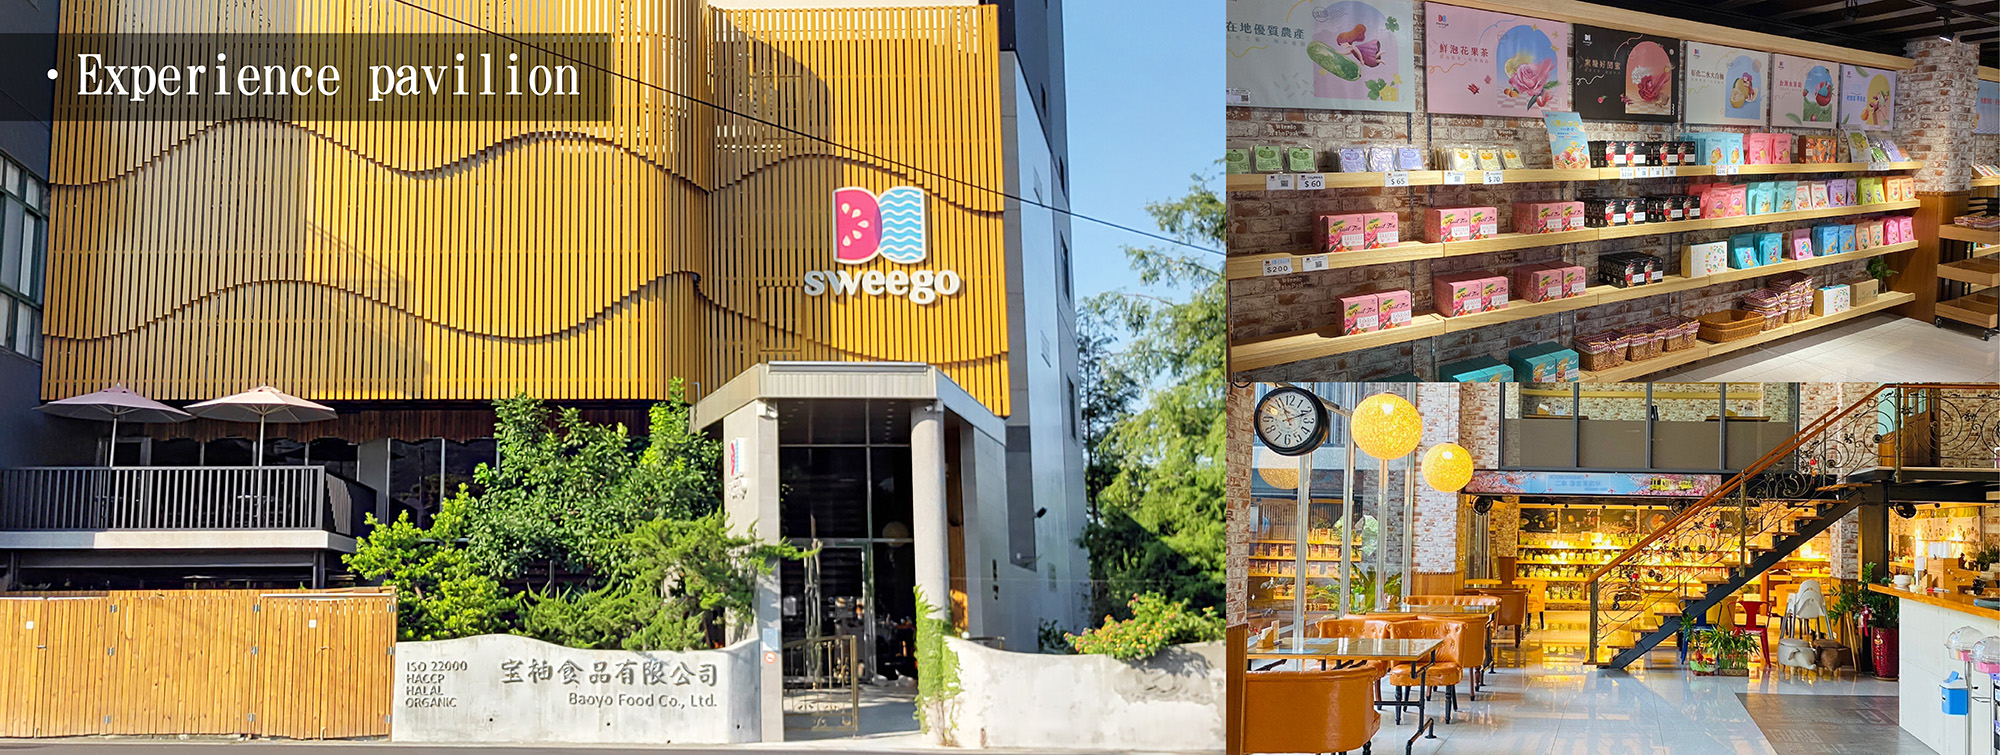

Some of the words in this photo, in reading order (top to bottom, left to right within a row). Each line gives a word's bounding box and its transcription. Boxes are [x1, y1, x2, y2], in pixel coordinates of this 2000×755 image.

[1226, 20, 1304, 40] 在地優質農產
[1440, 43, 1488, 58] 鮮泡花果茶
[804, 270, 961, 305] sweego
[1286, 395, 1295, 406] 12
[1297, 400, 1304, 408] 1
[1265, 425, 1276, 434] 8
[1301, 426, 1311, 434] 4
[1274, 431, 1282, 441] 7
[1284, 434, 1291, 445] 6
[1293, 431, 1302, 442] 5
[406, 662, 427, 672] ISO
[431, 660, 468, 672] 22000
[501, 658, 718, 687] 宝柚食品有限公司
[406, 673, 445, 684] HACCP
[406, 686, 444, 696] HALAL
[406, 697, 457, 708] ORGANIC
[569, 692, 613, 708] Baoyo
[618, 693, 654, 707] Food
[658, 694, 686, 708] Co.,
[690, 694, 717, 707] Ltd.
